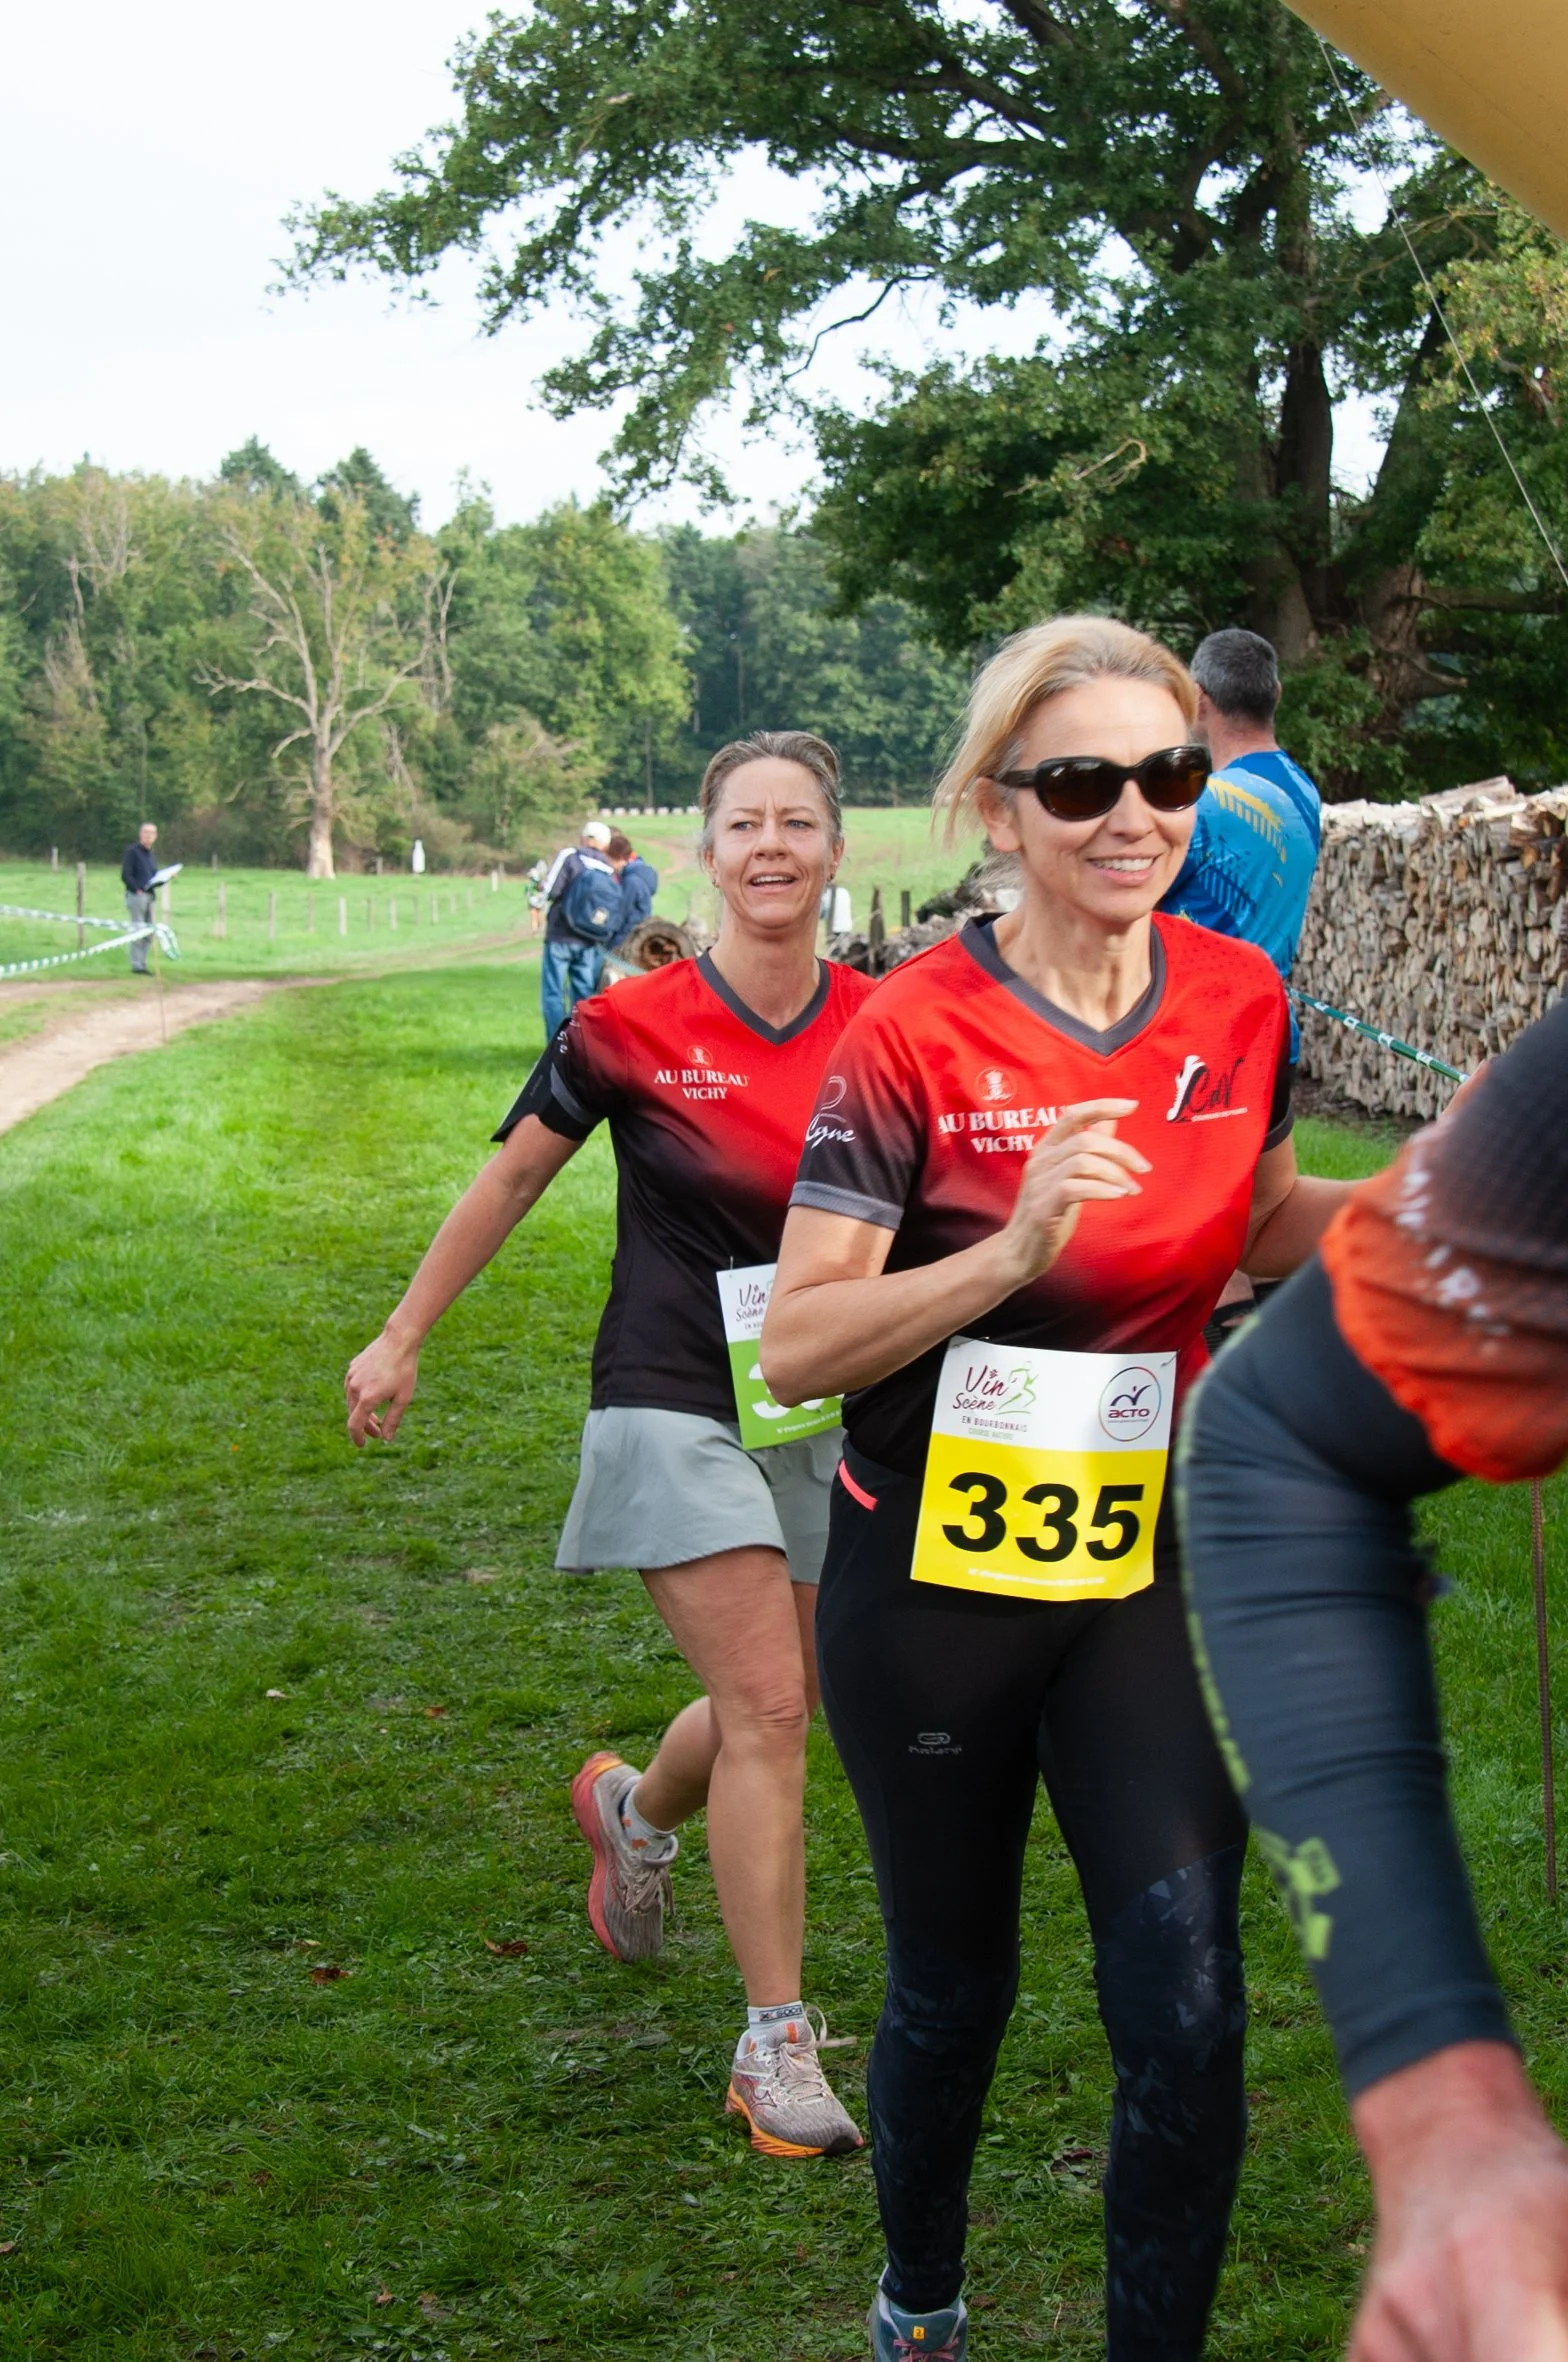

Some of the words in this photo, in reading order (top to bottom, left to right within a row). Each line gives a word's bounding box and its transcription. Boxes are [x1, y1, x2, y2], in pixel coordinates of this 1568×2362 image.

[654, 1069, 678, 1084] AU
[681, 1069, 748, 1087] BUREAU
[682, 1087, 727, 1100] VICHY
[937, 1112, 965, 1135] AU
[971, 1134, 1035, 1154] VICHY
[952, 1392, 997, 1411] Scène
[961, 1415, 972, 1424] EN
[974, 1417, 1028, 1433] BOURBONNAIS
[942, 1471, 1145, 1563] 335
